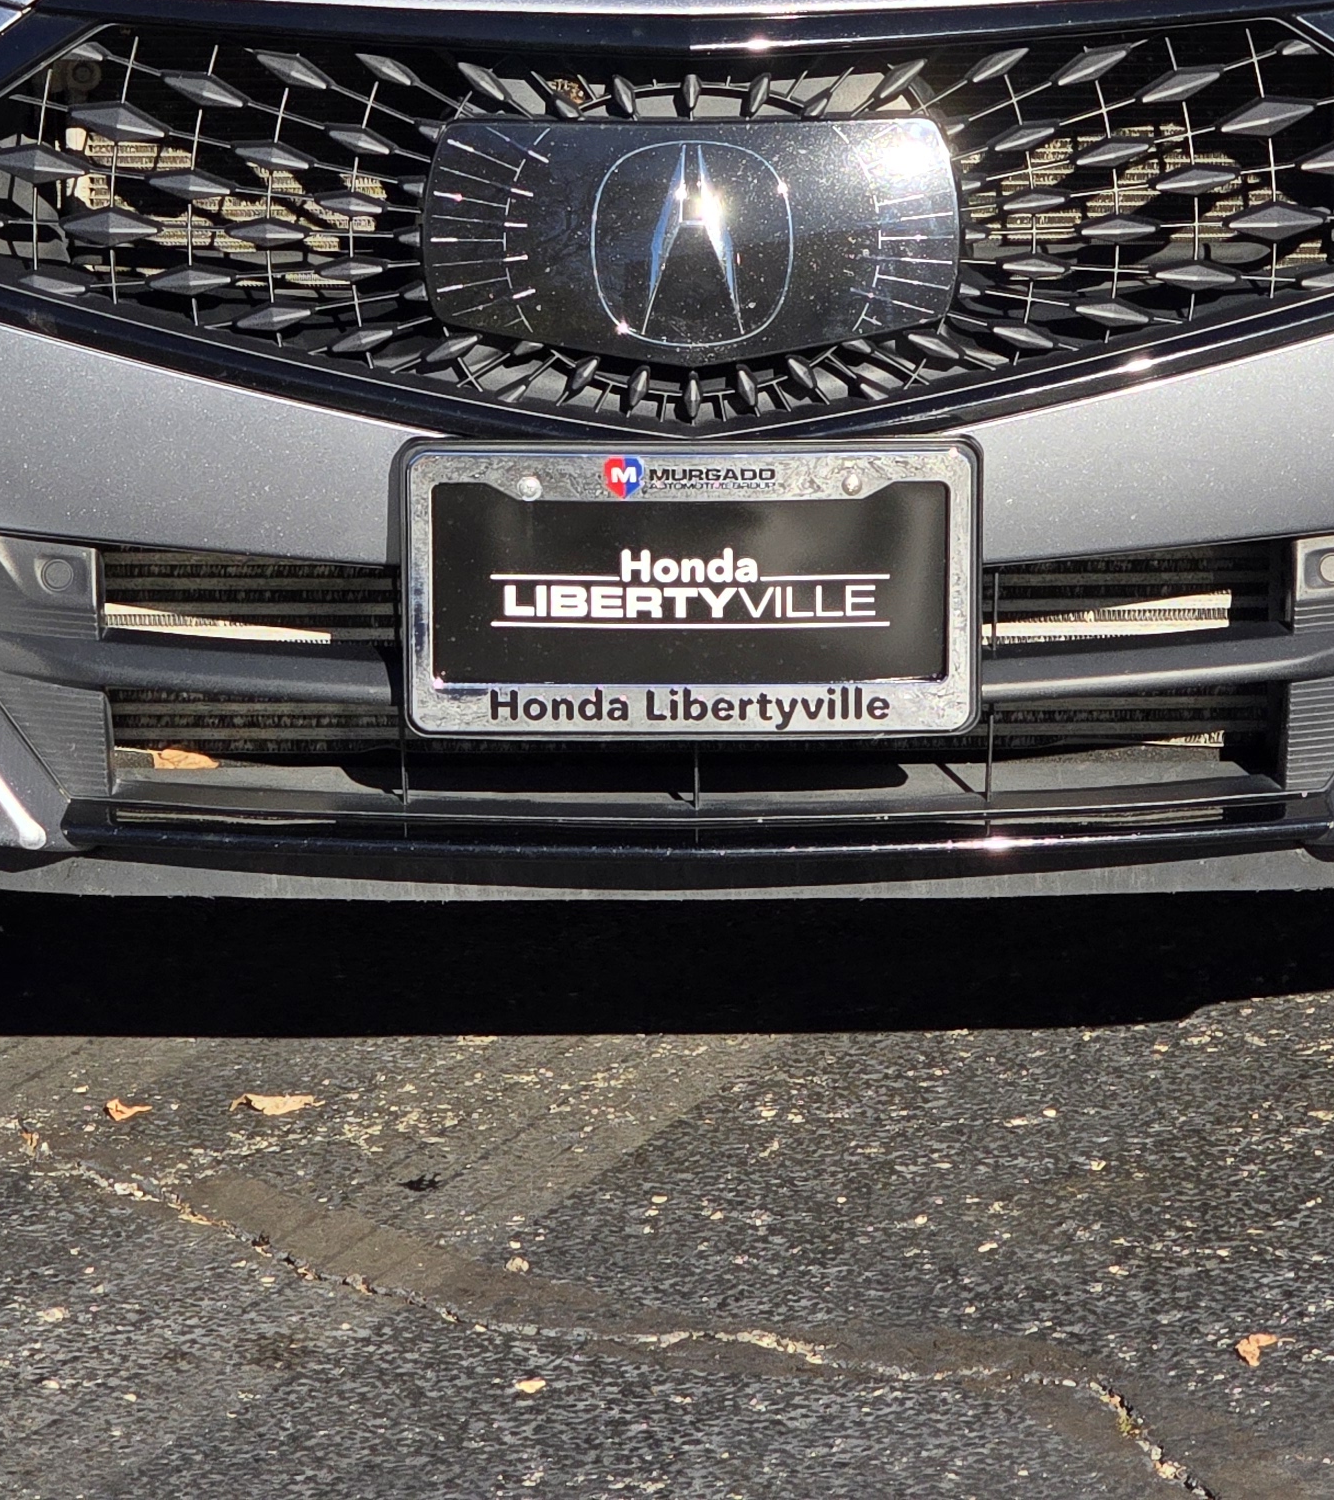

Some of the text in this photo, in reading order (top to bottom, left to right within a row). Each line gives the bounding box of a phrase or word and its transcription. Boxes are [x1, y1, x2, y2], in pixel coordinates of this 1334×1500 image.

[648, 482, 777, 490] AUTOMOTIVE GROUP
[649, 468, 776, 482] MURGADO
[620, 547, 759, 584] Honda
[503, 584, 877, 619] LIBERTYVILLE
[490, 686, 890, 731] Honda Libertyville
